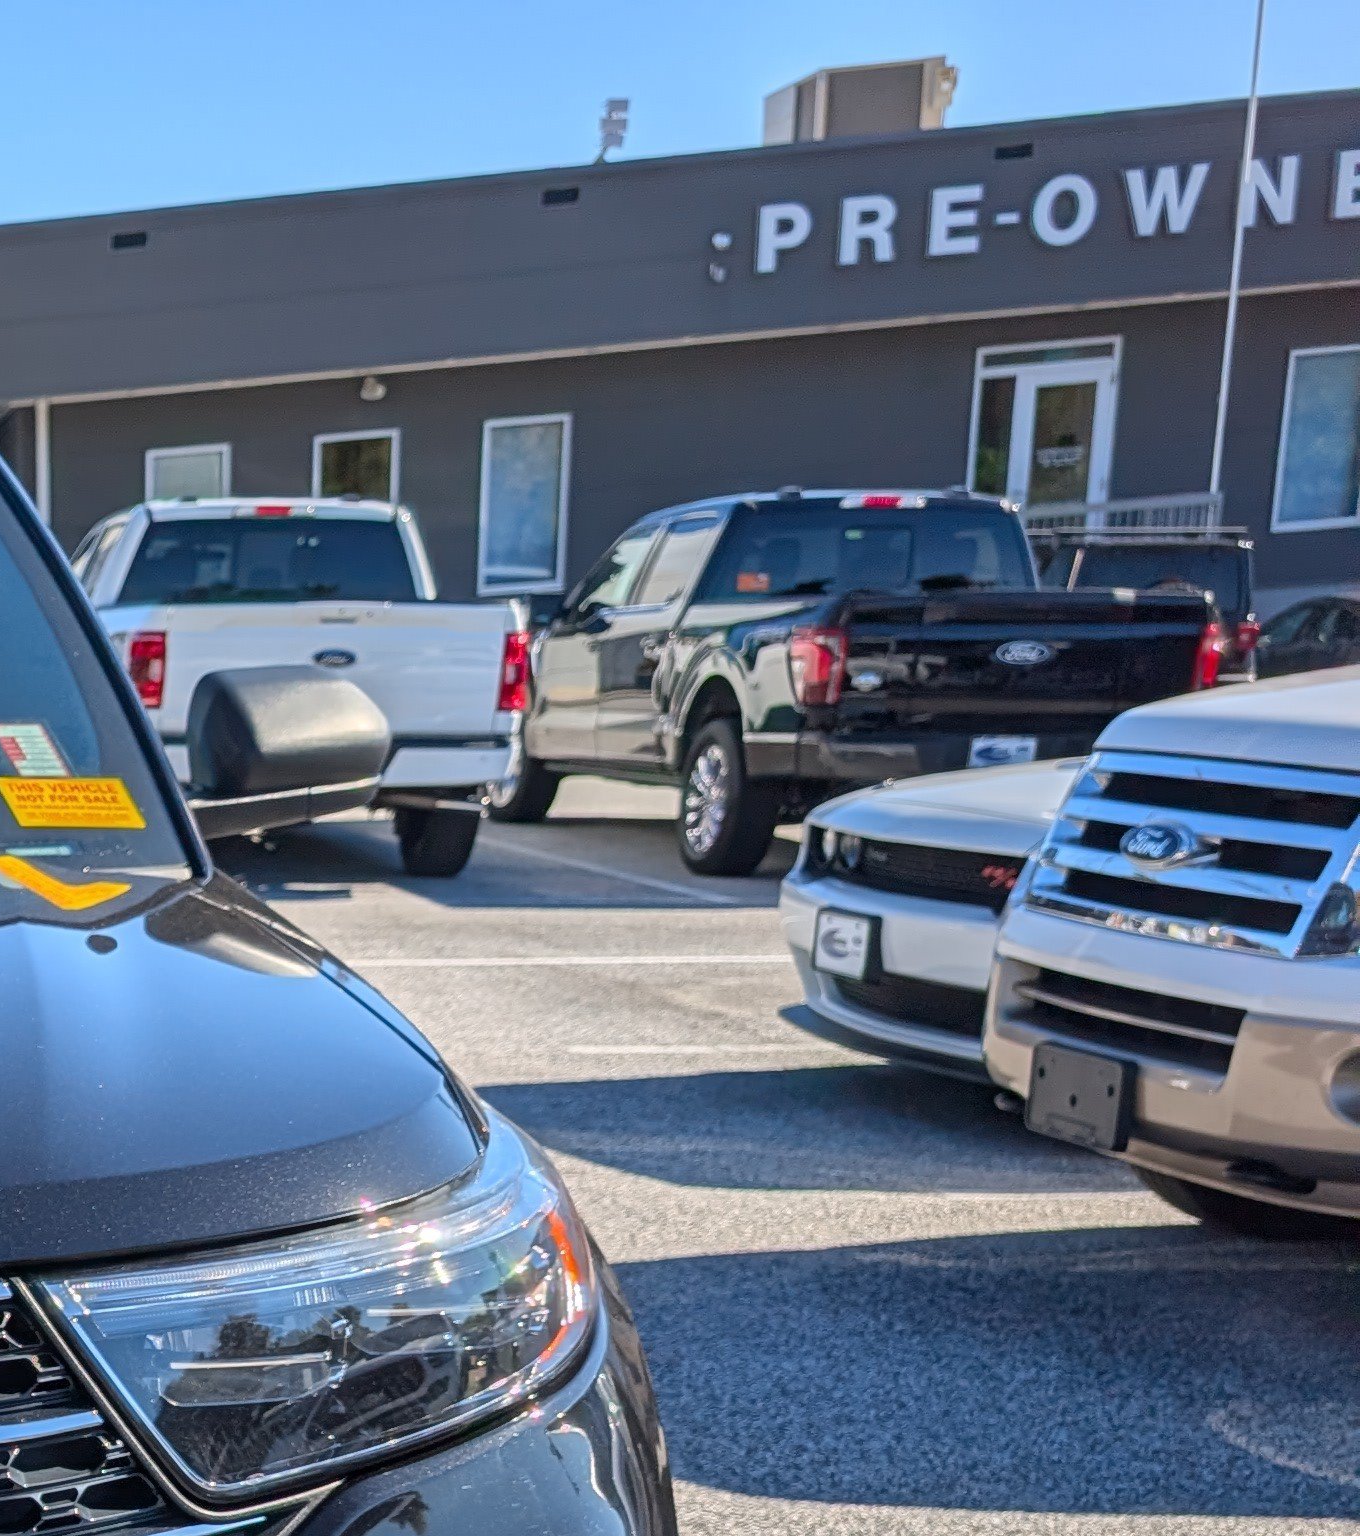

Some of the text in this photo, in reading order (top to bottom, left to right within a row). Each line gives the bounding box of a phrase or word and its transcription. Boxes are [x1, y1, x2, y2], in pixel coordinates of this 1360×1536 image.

[7, 782, 119, 794] THIS VEHICLE
[16, 794, 120, 804] NOT FOR SALE
[1127, 826, 1172, 859] Ford
